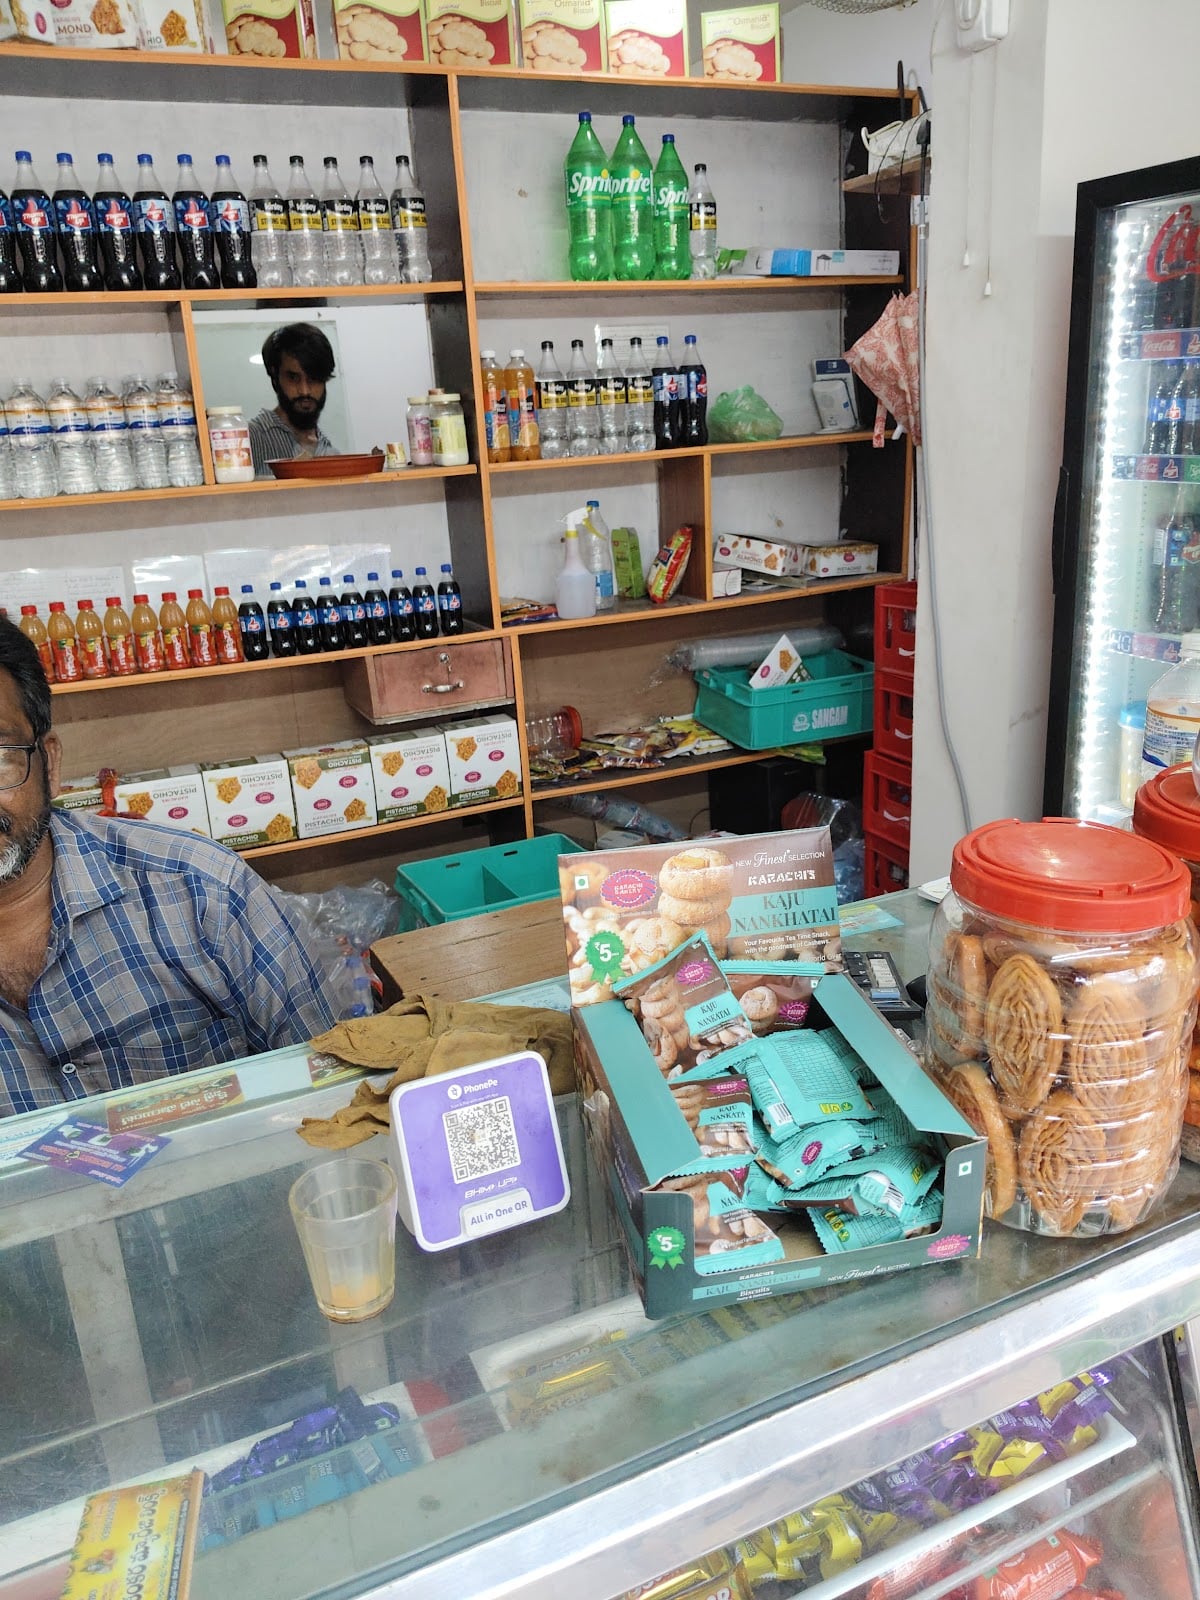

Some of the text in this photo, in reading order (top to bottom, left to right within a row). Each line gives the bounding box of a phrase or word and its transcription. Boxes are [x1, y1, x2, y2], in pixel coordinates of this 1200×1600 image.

[811, 706, 848, 730] SANGAM
[476, 732, 512, 743] PISTACHIO
[403, 746, 441, 758] PISTACHIO
[328, 757, 362, 768] PISTACHIO
[241, 772, 283, 784] PISTACHIO
[153, 786, 197, 799] PISTACHIO
[458, 788, 490, 799] PISTACHIO
[385, 804, 418, 816] PISTACHIO
[304, 816, 344, 828] PISTACHIO
[222, 833, 259, 845] PISTACHIO
[753, 852, 787, 868] Finest
[788, 851, 825, 861] SELECTION
[748, 869, 816, 886] KARACHI'S
[763, 891, 805, 910] KAJU
[735, 907, 836, 933] NANKHATAI
[744, 939, 758, 947] Your
[758, 937, 785, 945] Favourite
[768, 944, 795, 952] goodness
[700, 1000, 718, 1014] KAJU
[697, 1008, 731, 1027] NANKATAI
[463, 1079, 498, 1095] PhonePe
[465, 1184, 495, 1199] BHIM
[470, 1200, 528, 1226] All in One QR
[844, 1265, 880, 1280] Finest
[877, 1262, 911, 1272] SELECTION
[740, 1286, 771, 1297] Biscuits
